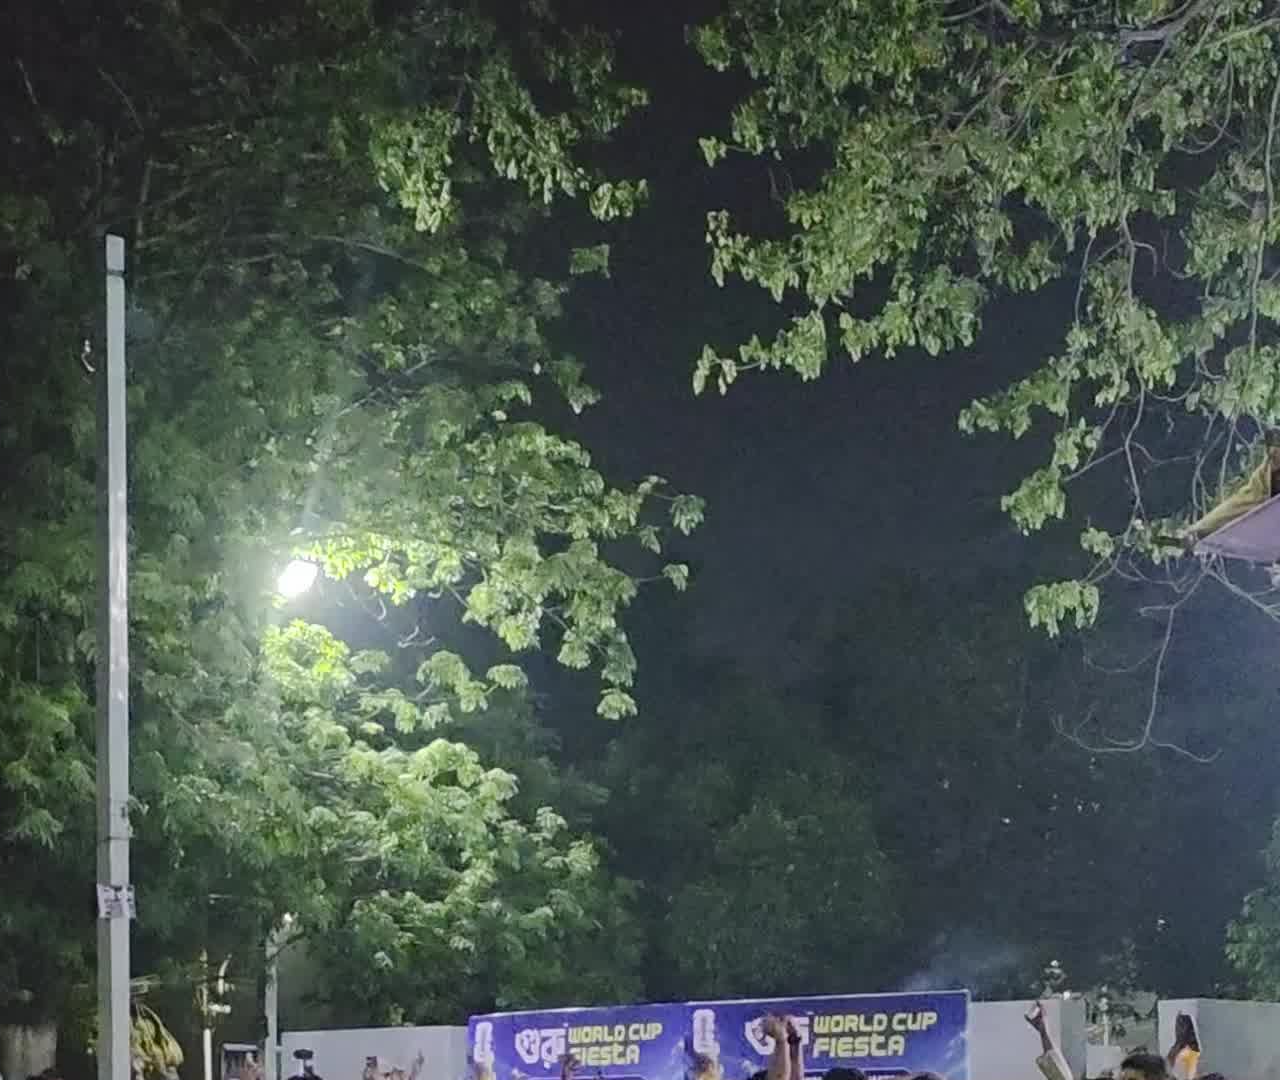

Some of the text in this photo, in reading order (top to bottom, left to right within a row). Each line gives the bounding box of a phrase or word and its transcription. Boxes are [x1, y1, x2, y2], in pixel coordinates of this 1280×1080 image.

[568, 1023, 663, 1044] WORLD CUP
[812, 1011, 937, 1034] WORLD CUP
